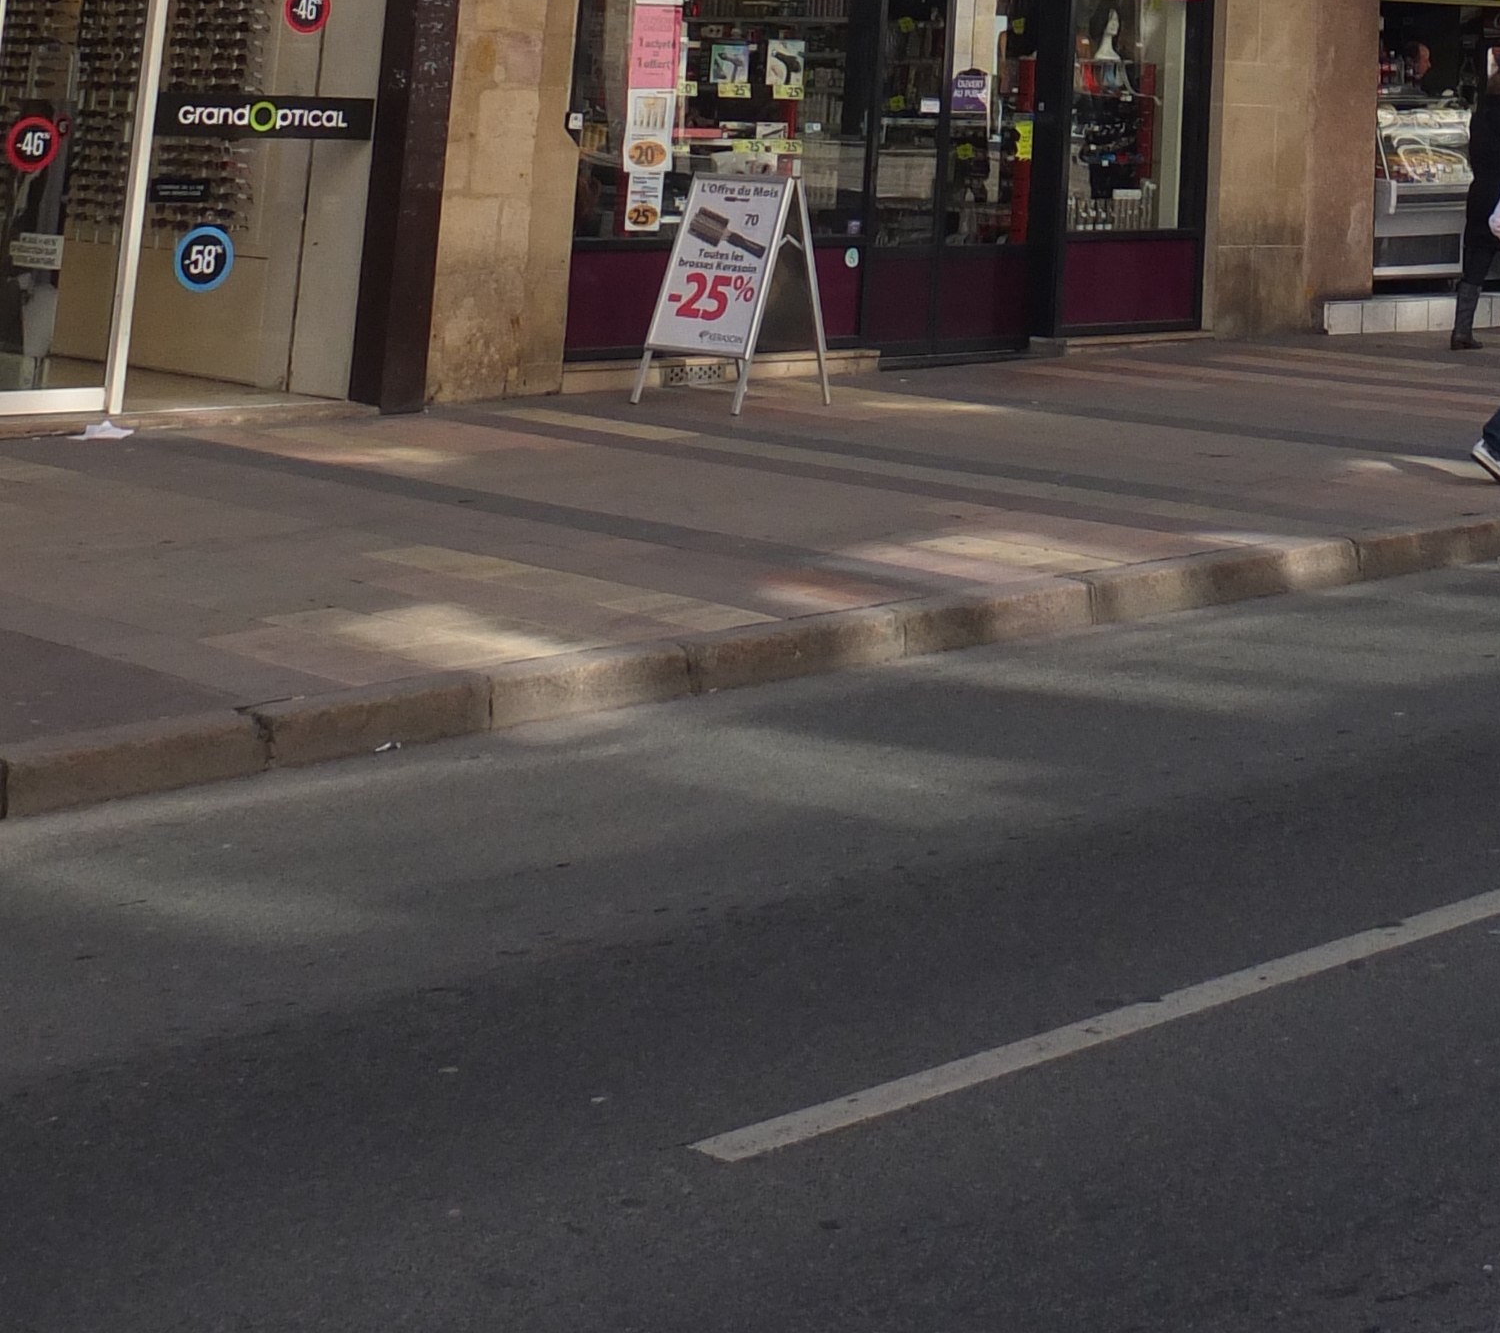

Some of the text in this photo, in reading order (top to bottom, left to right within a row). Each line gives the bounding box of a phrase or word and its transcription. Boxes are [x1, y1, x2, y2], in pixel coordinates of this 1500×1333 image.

[738, 185, 751, 196] du
[753, 186, 779, 198] Mois
[698, 248, 744, 262] Toutes les
[678, 256, 713, 270] brosses
[668, 272, 755, 321] -25%
